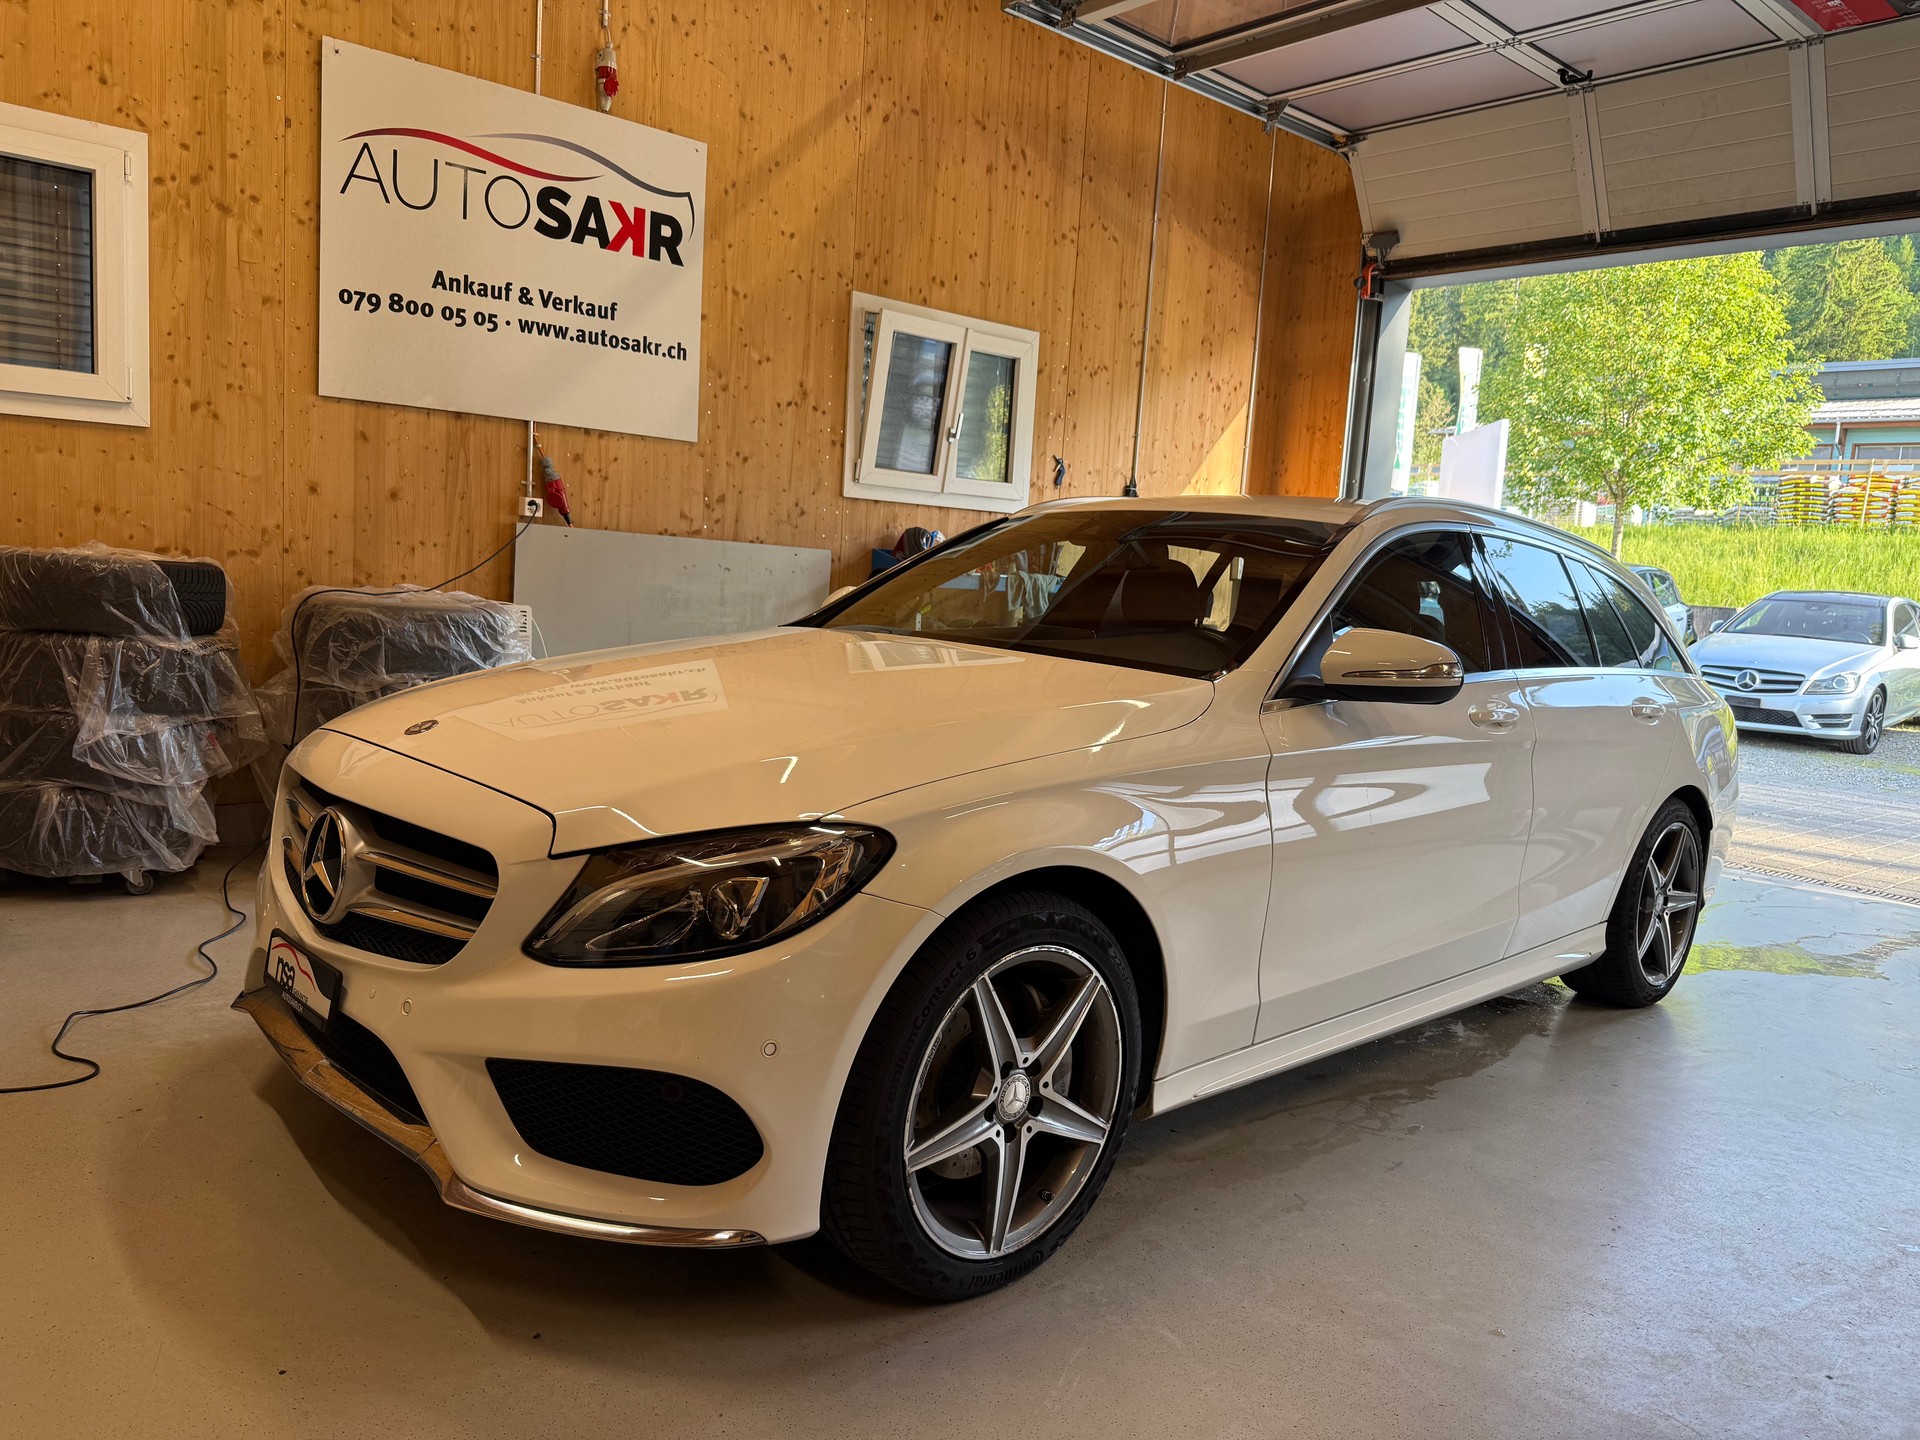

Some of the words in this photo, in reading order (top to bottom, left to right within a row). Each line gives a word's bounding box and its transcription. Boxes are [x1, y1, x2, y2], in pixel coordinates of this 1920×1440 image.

[339, 142, 684, 267] AUTOSAKR
[338, 288, 382, 314] 079
[388, 292, 435, 318] 800
[440, 306, 467, 328] 05
[473, 311, 499, 333] 05
[518, 318, 688, 362] www.autosakr.ch
[431, 270, 514, 303] Ankauf
[518, 287, 535, 307] &
[537, 288, 618, 322] Verkauf
[880, 959, 965, 1128] PremiumContact
[966, 946, 978, 962] 6
